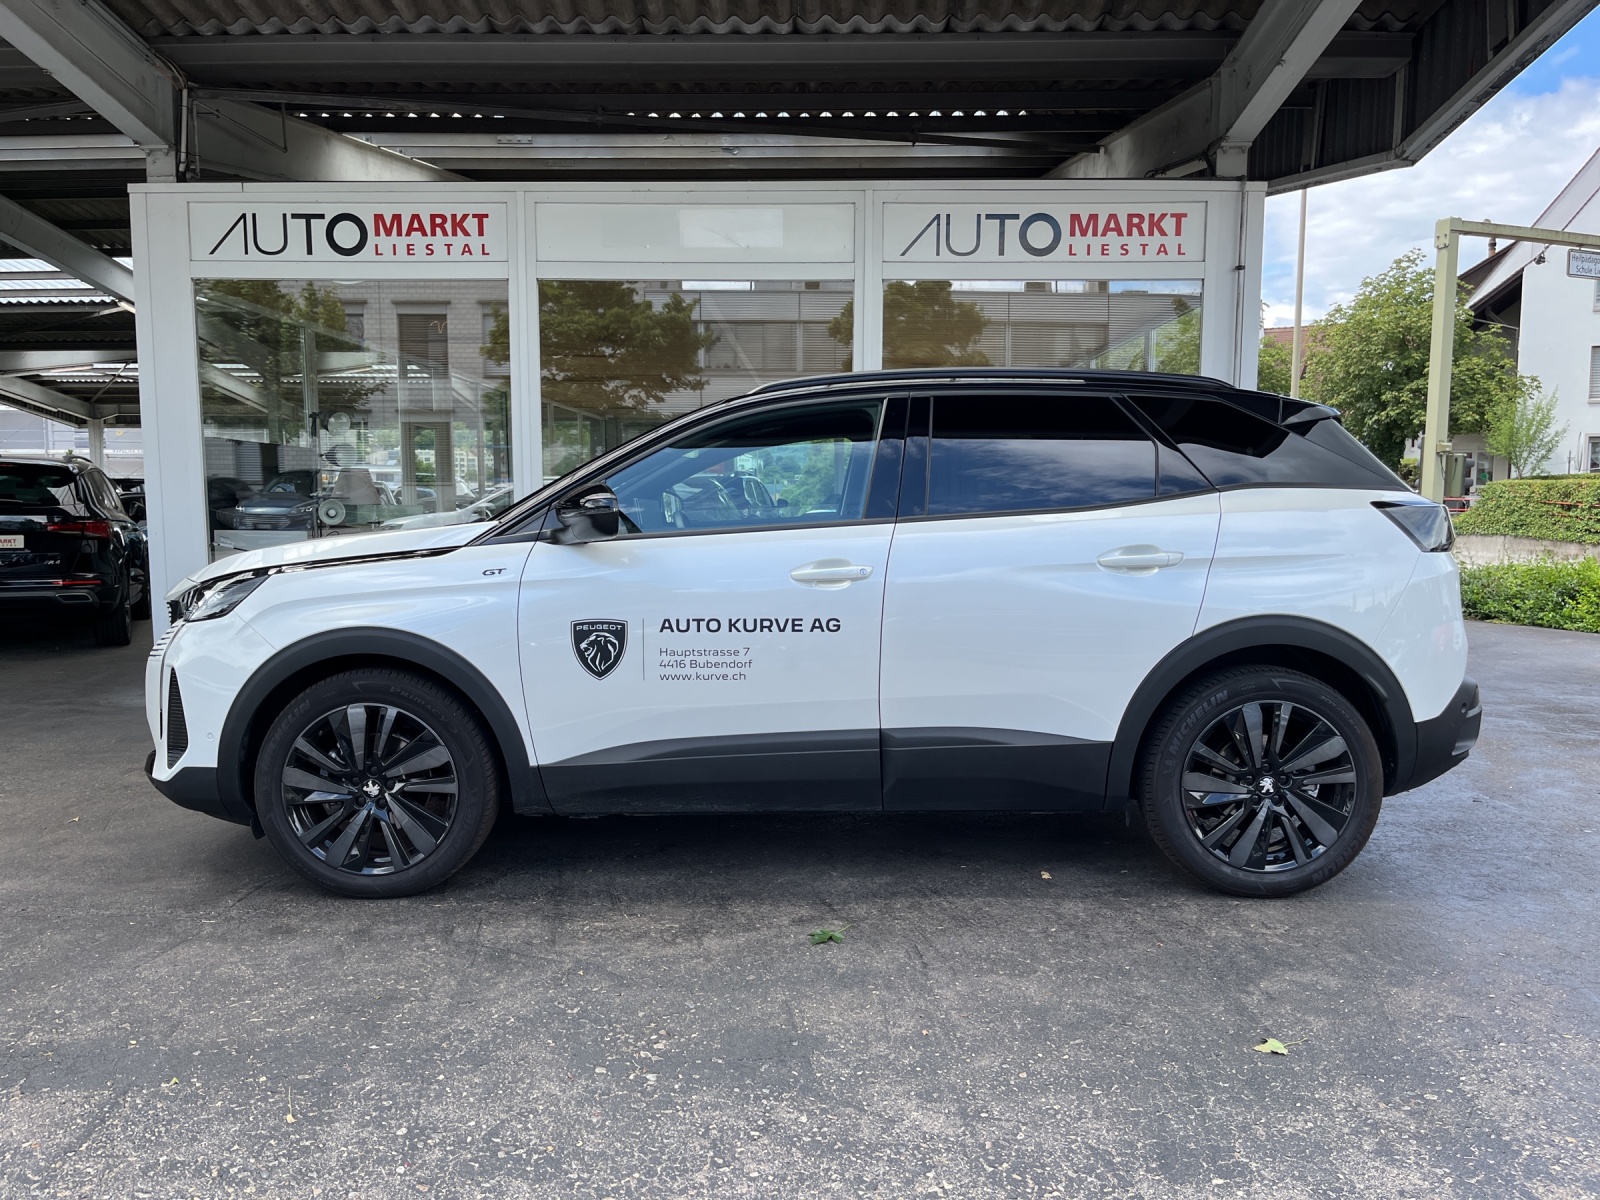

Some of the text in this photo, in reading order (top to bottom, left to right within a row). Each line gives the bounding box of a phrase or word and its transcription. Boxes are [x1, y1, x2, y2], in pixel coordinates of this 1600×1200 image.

[209, 213, 489, 256] AUTO MARKT
[899, 213, 1188, 257] AUTO MARKT
[374, 243, 490, 256] LIESTAL
[1068, 243, 1186, 256] LIESTAL
[481, 567, 507, 576] GT
[659, 618, 841, 633] AUTO KURVE AG
[659, 647, 750, 658] Hauptstrasse 7
[659, 659, 753, 669] 4416 Bubendorf
[659, 671, 747, 681] www.kurve.ch
[1170, 689, 1229, 757] MICHELIN
